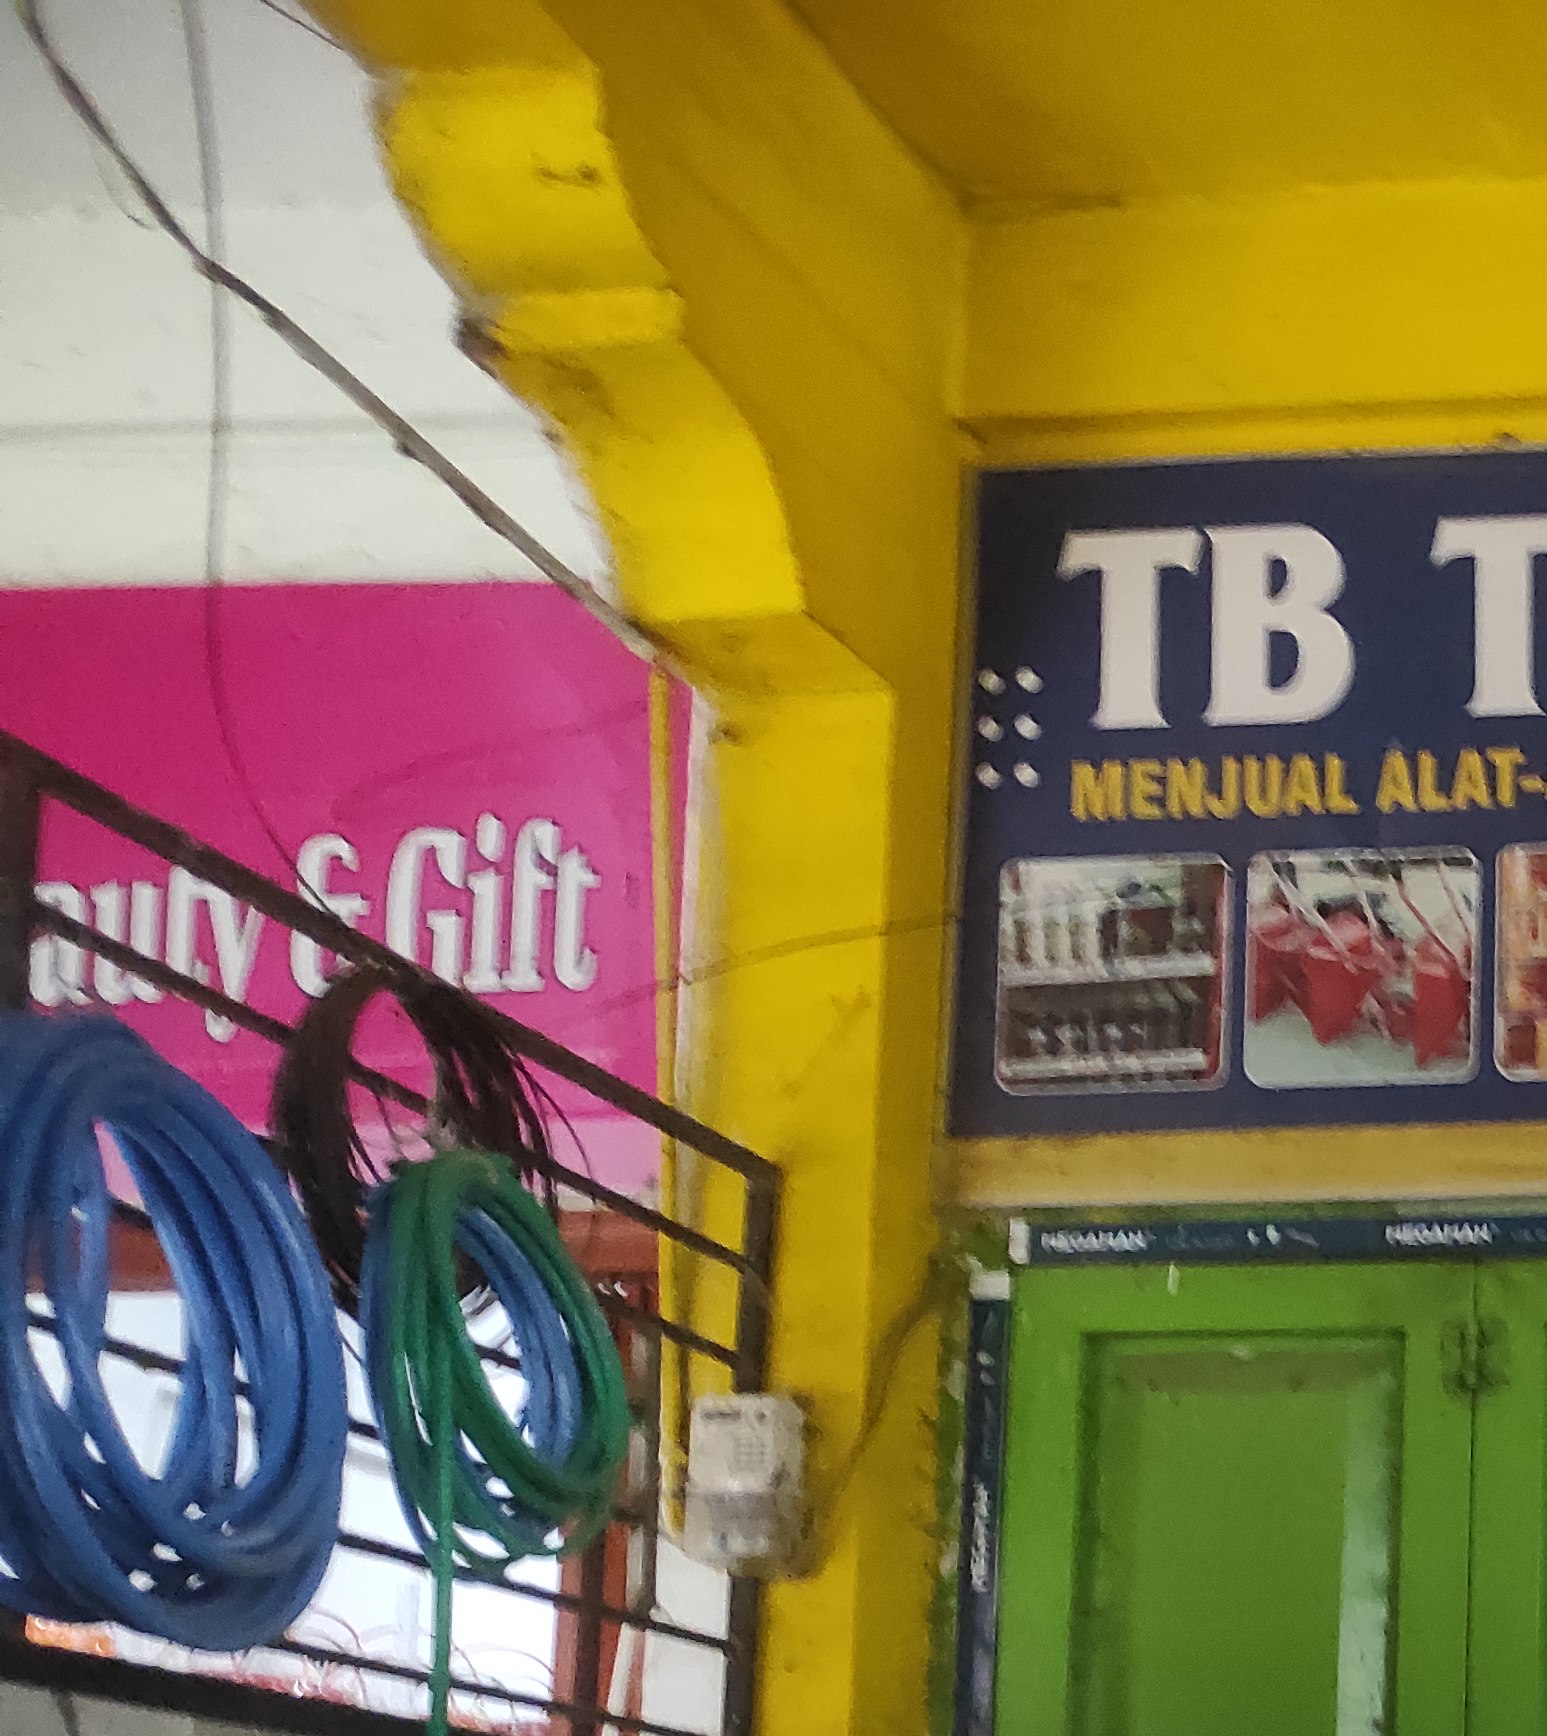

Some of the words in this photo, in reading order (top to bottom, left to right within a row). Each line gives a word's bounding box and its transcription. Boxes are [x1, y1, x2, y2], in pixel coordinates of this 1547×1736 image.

[1055, 520, 1356, 731] TB
[1069, 748, 1358, 821] MENJUAL
[386, 811, 600, 994] Gift
